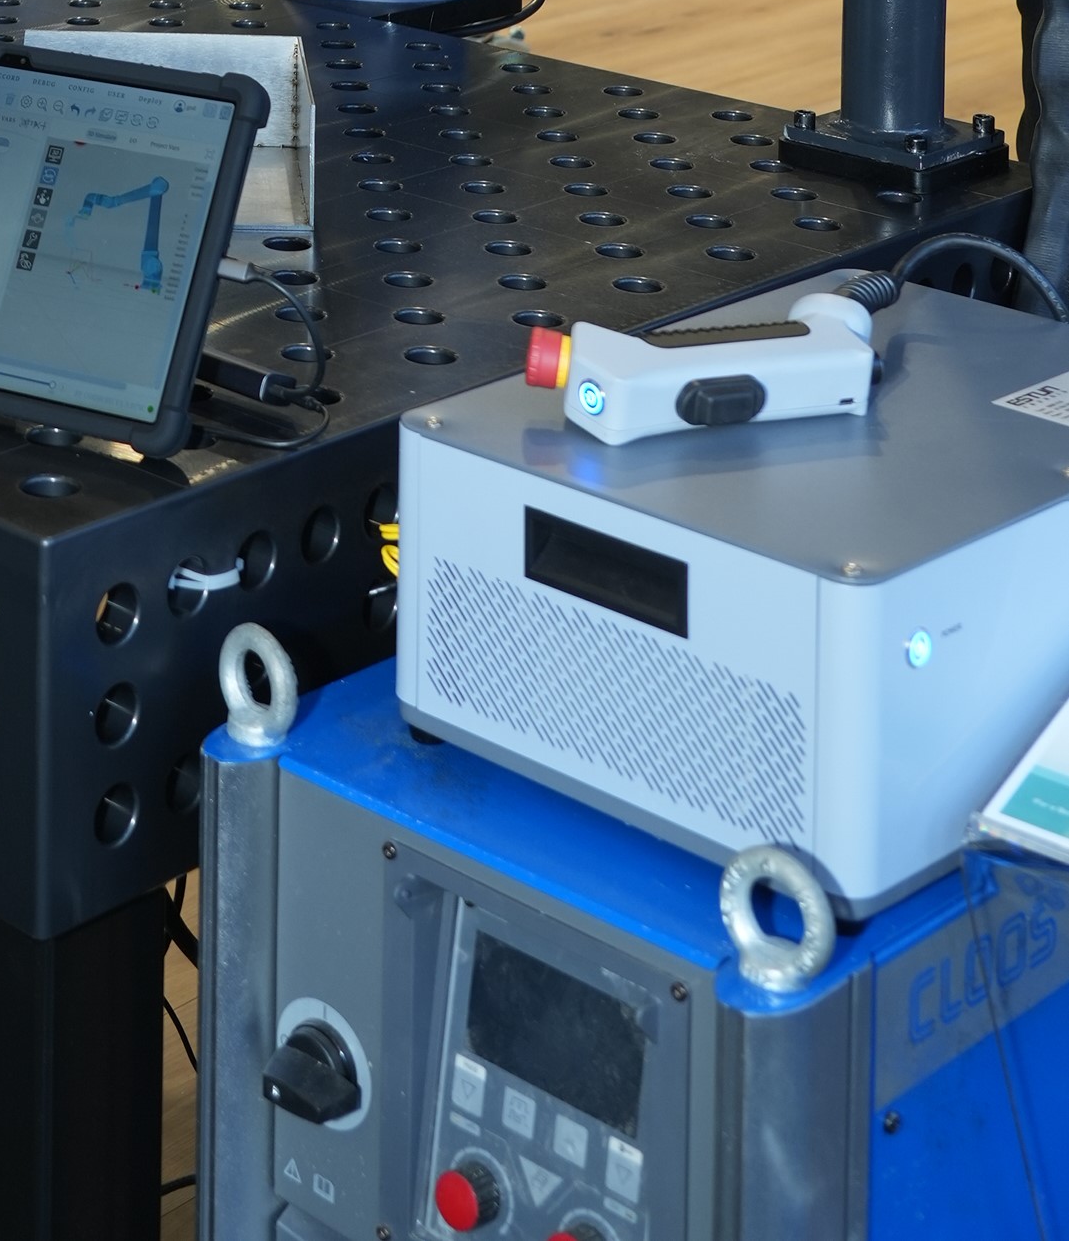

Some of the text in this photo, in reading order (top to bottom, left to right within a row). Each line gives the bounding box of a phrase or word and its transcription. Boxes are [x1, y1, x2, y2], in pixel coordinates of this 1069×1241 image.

[33, 77, 56, 88] DEBUG
[68, 83, 95, 95] CONFIG
[107, 90, 126, 99] USER
[138, 94, 163, 106] Deploy
[1006, 385, 1061, 406] ESTUN
[906, 911, 1058, 1047] CLOOS
